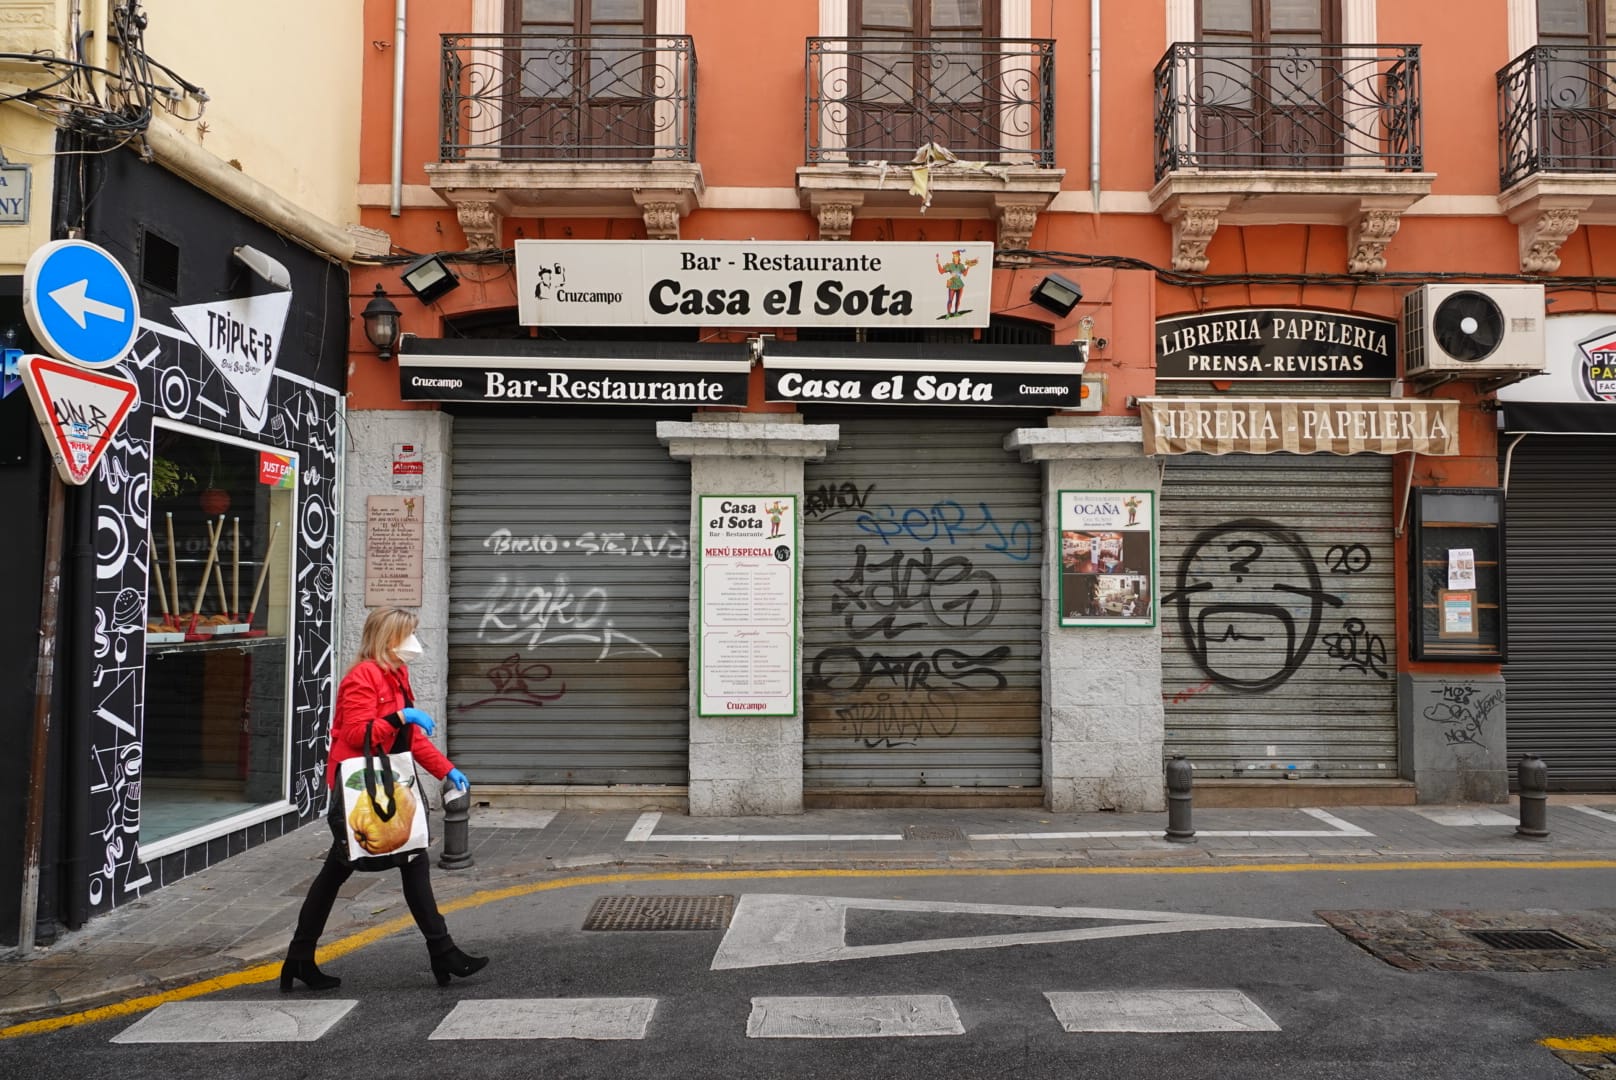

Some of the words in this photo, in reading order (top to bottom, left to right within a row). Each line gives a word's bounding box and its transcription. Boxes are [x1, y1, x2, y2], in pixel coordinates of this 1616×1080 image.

[681, 252, 721, 270] Bar
[743, 252, 882, 272] Restaurante
[556, 289, 623, 305] Cruzcampo
[648, 279, 751, 315] Casa
[763, 280, 803, 315] el
[814, 280, 913, 316] Sota
[1160, 318, 1262, 357] LIBRERIA
[1271, 318, 1389, 357] PAPELERIA
[1188, 354, 1364, 372] PRENSA-REVISTAS
[1591, 367, 1616, 379] PA
[411, 376, 463, 390] Cruzcampo
[484, 371, 724, 401] Bar-Restaurante
[777, 373, 862, 399] Casa
[871, 375, 904, 400] el
[913, 375, 993, 401] Sota
[1019, 384, 1069, 396] Cruzcampo
[1152, 408, 1279, 440] LIBRERIA
[1302, 409, 1450, 440] PAPELERIA
[263, 461, 280, 473] JUST
[280, 464, 293, 476] EAT
[721, 501, 757, 514] Casa
[1073, 503, 1121, 515] OCAÑA
[709, 516, 724, 529] el
[727, 516, 763, 529] Sota
[705, 546, 730, 557] MENÚ
[732, 548, 773, 557] ESPECIAL
[726, 701, 767, 712] Cruzcampo
